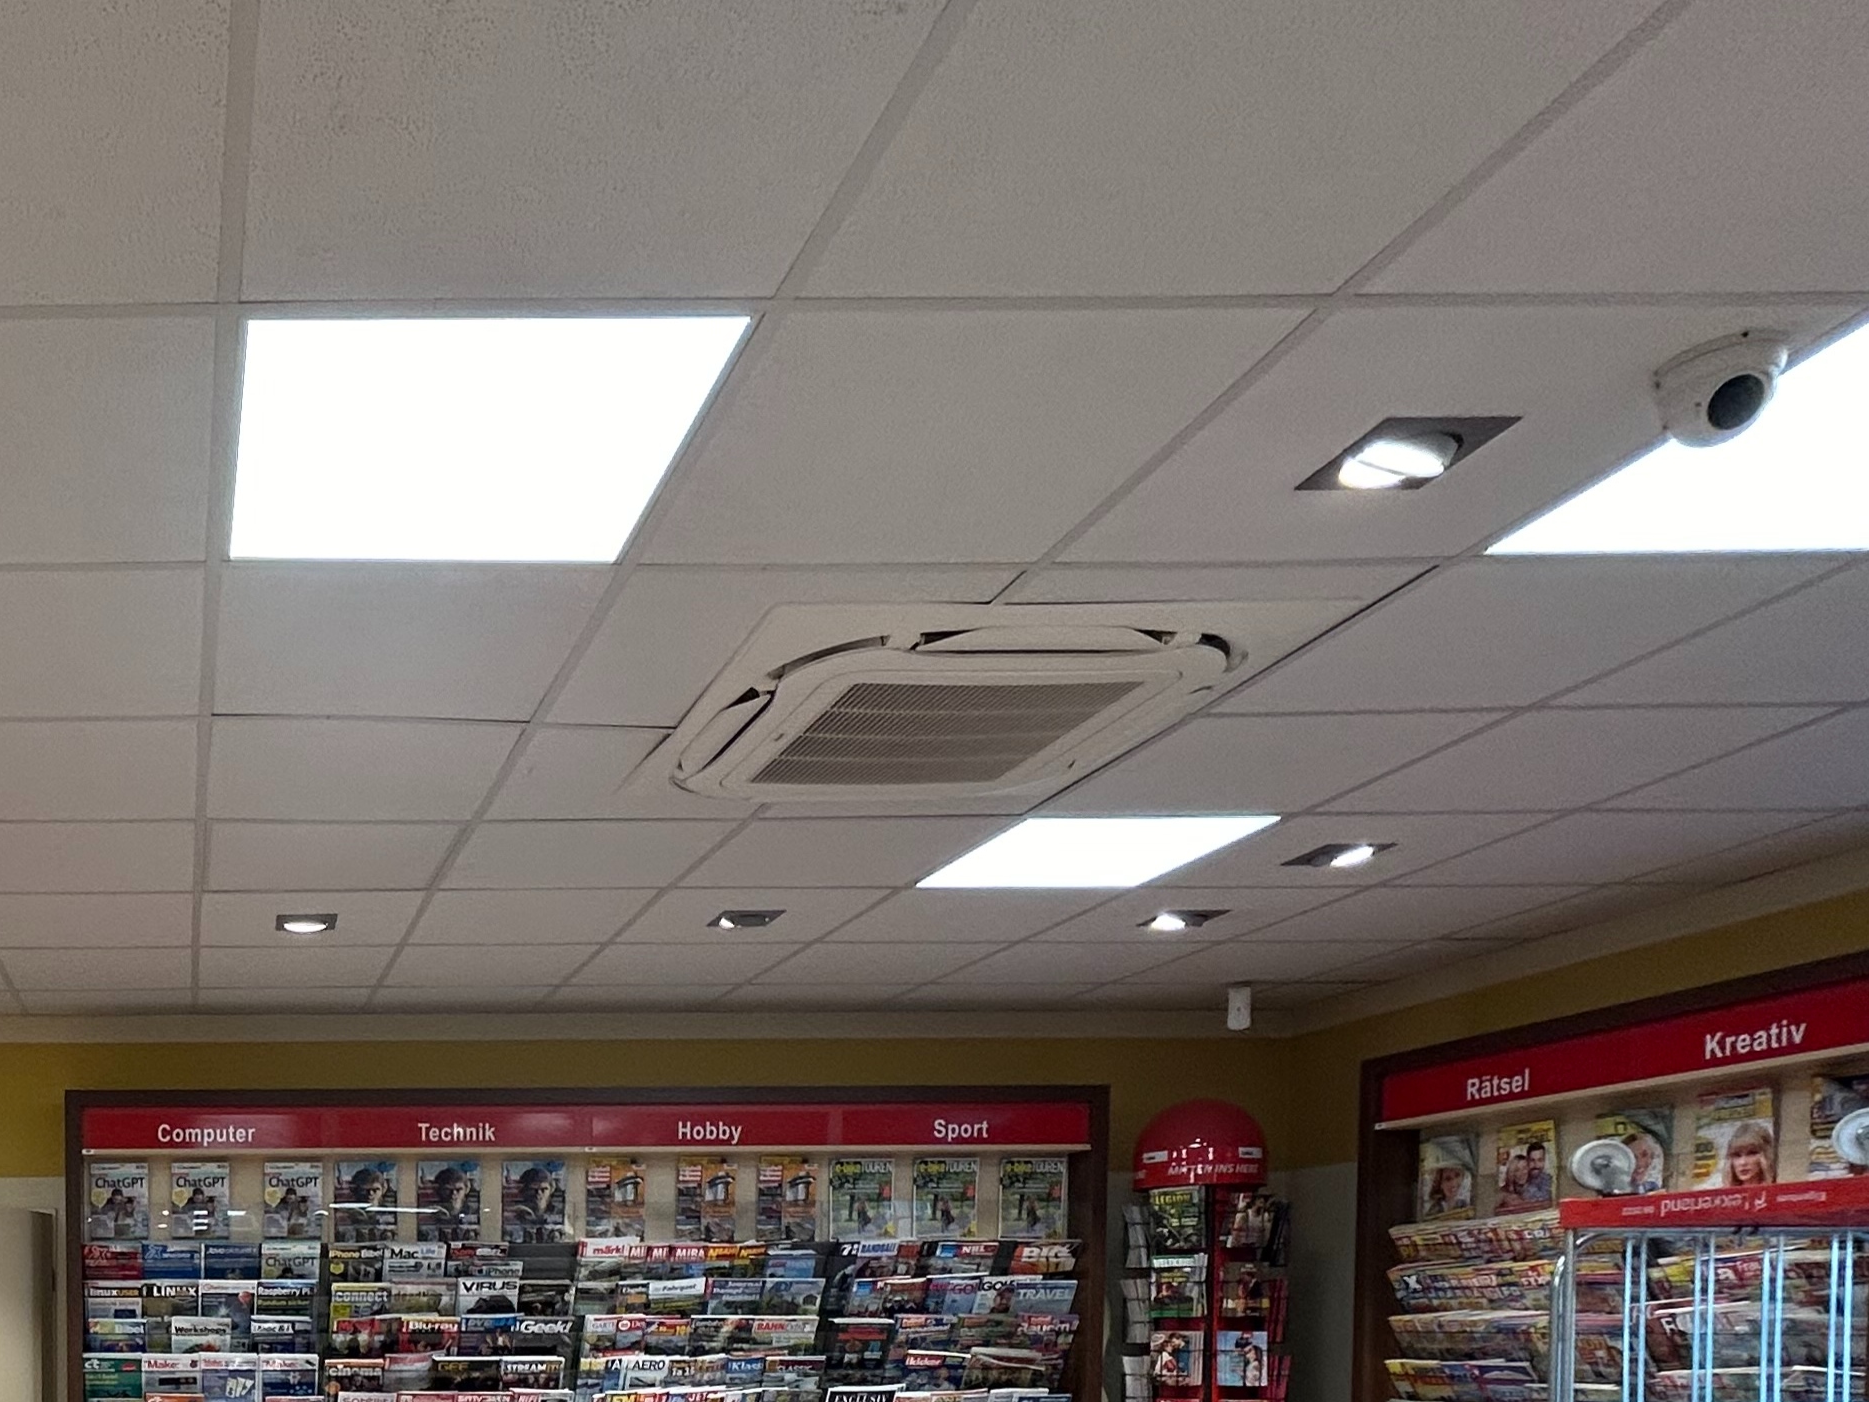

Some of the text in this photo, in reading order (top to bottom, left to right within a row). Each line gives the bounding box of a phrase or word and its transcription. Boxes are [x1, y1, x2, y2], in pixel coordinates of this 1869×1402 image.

[1704, 1020, 1806, 1059] Kreativ
[1466, 1069, 1530, 1100] Rätsel
[157, 1124, 255, 1143] Computer
[418, 1123, 496, 1142] Technik
[677, 1121, 742, 1145] Hobby
[933, 1119, 988, 1141] Sport
[95, 1177, 145, 1189] ChatGPT
[176, 1177, 226, 1189] ChatGPT
[269, 1177, 319, 1189] ChatGPT
[390, 1248, 418, 1259] Mac
[265, 1256, 316, 1268] ChatGPT
[258, 1286, 298, 1296] Raspberry
[462, 1281, 518, 1293] VIRUS
[335, 1291, 388, 1302] connect
[1019, 1289, 1071, 1300] TRAVEL
[174, 1325, 226, 1335] Workshops
[520, 1321, 572, 1333] Geek!
[632, 1359, 666, 1370] AERO
